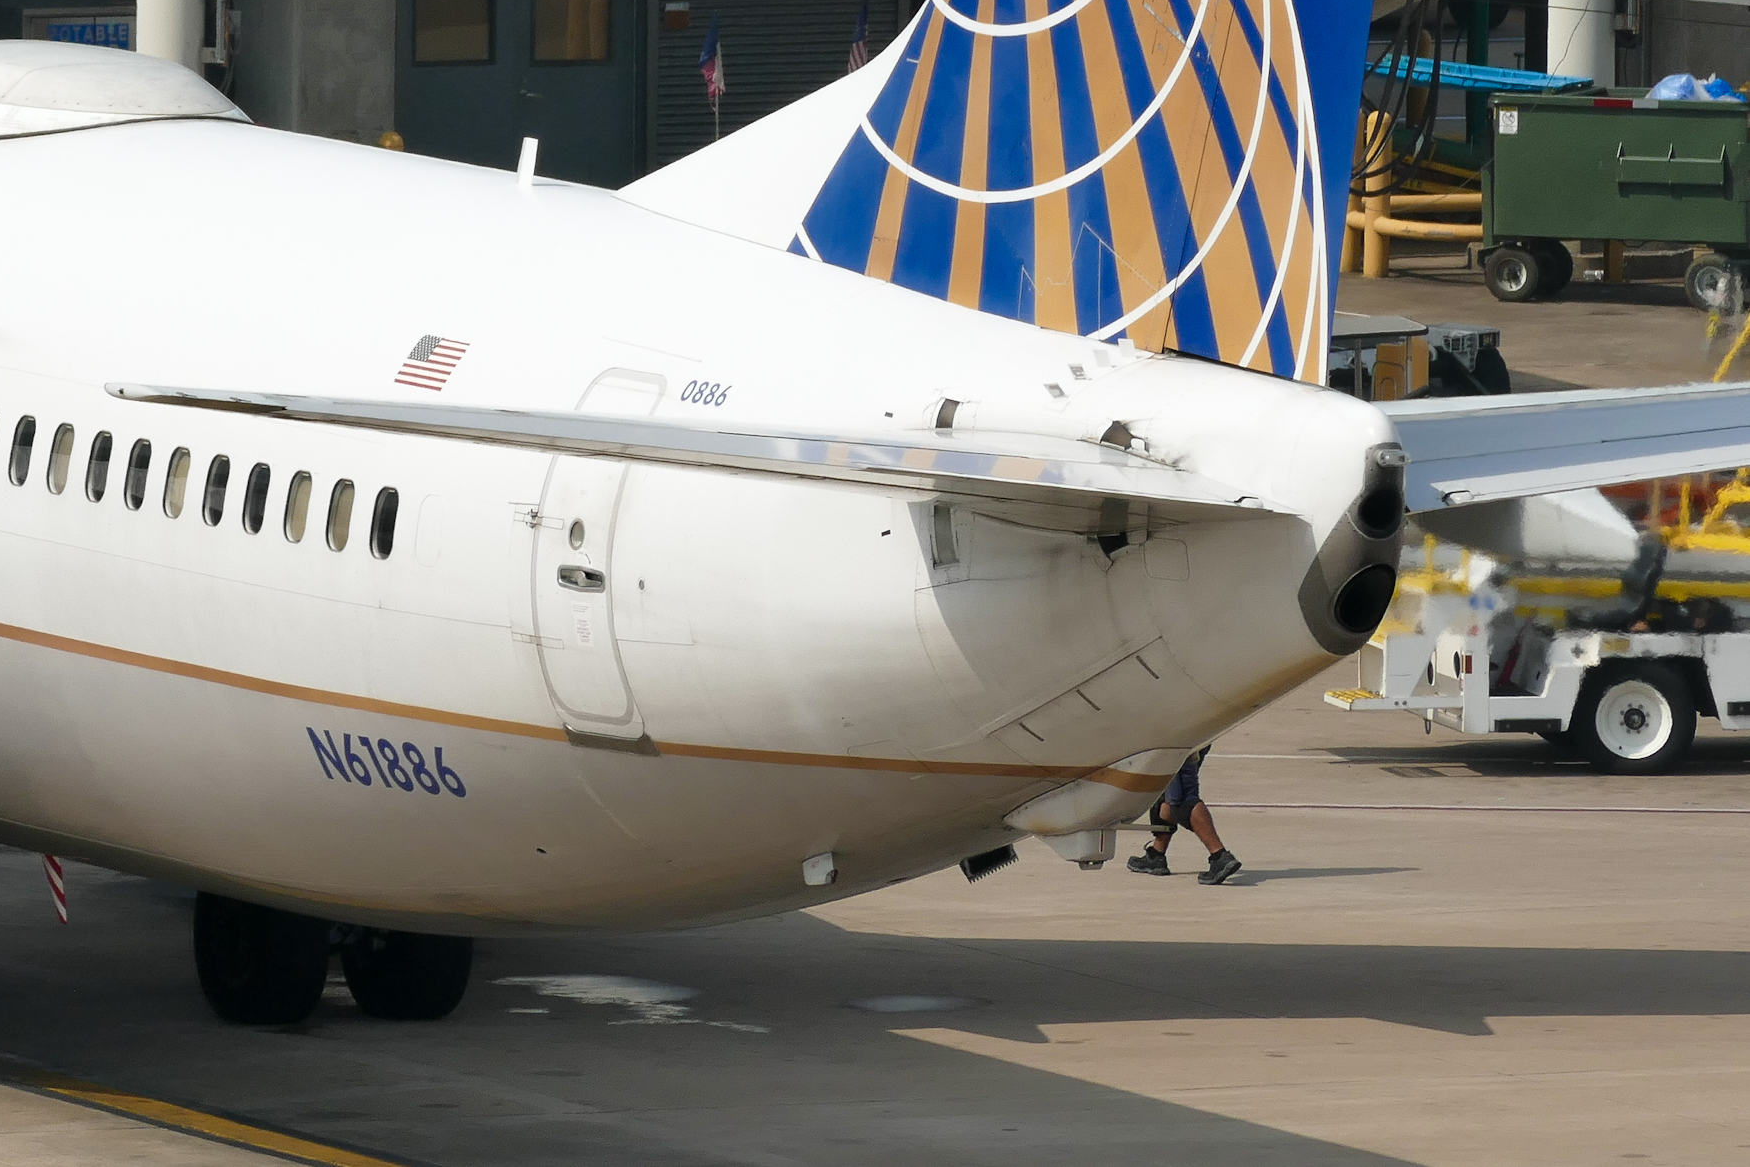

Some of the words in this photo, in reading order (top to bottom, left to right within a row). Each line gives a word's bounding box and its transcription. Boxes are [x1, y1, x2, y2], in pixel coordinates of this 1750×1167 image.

[48, 23, 129, 42] POTABLE
[680, 380, 732, 407] 0886
[306, 726, 467, 798] N61886
